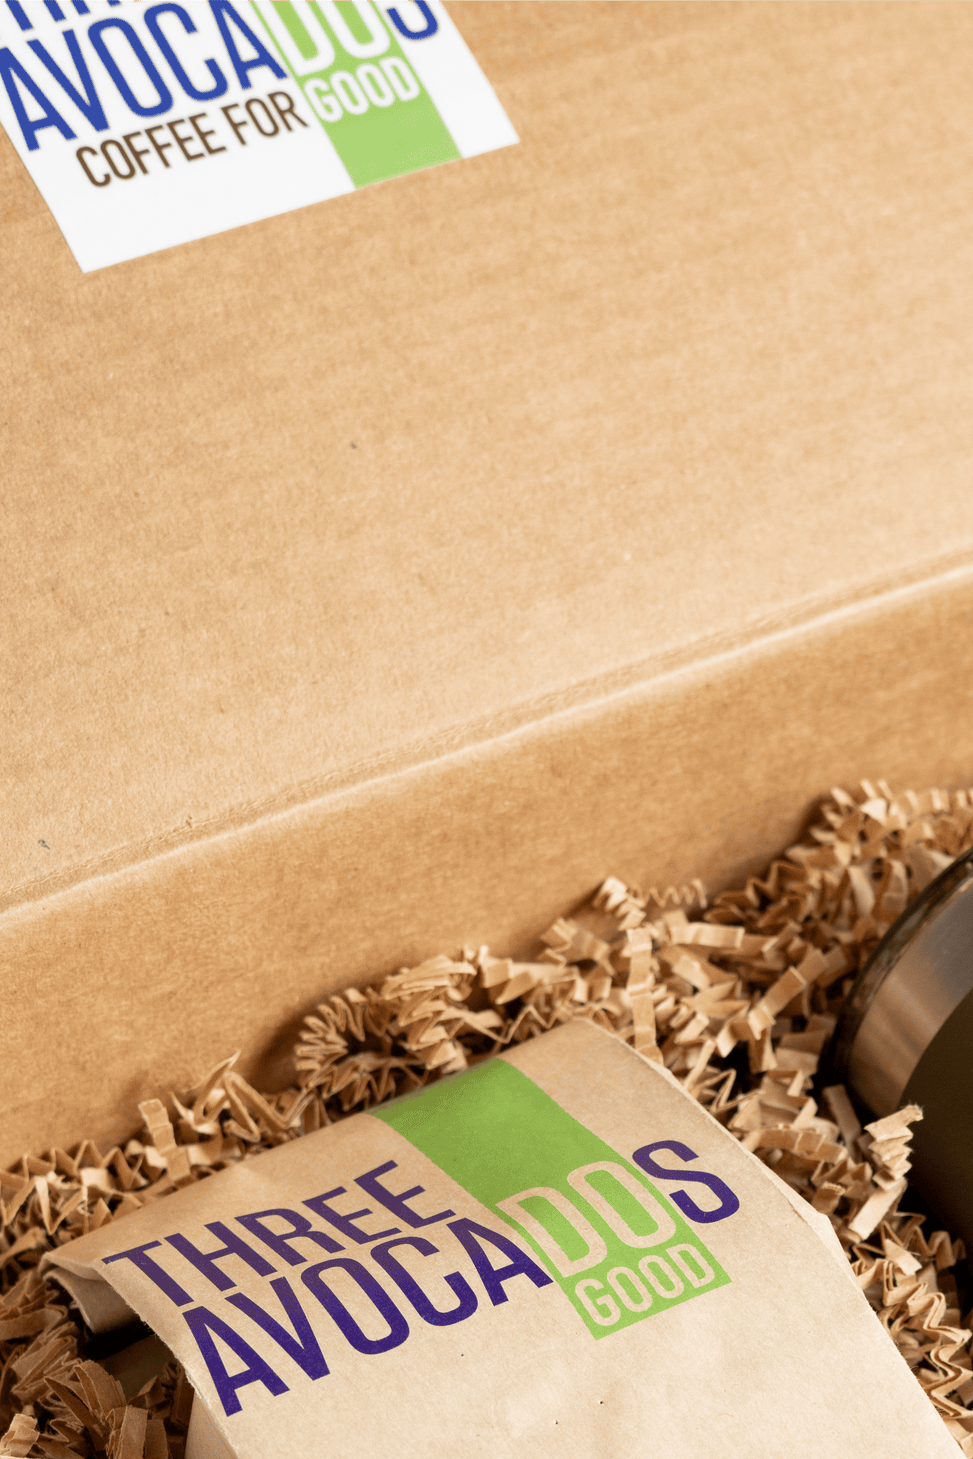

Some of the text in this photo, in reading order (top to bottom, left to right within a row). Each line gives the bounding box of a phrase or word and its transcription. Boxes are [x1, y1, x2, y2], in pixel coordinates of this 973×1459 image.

[75, 56, 421, 187] COFFEE FOR GOOD
[102, 1159, 457, 1307] THREE
[182, 1140, 740, 1417] AVOCADOS
[574, 1243, 714, 1326] GOOD
